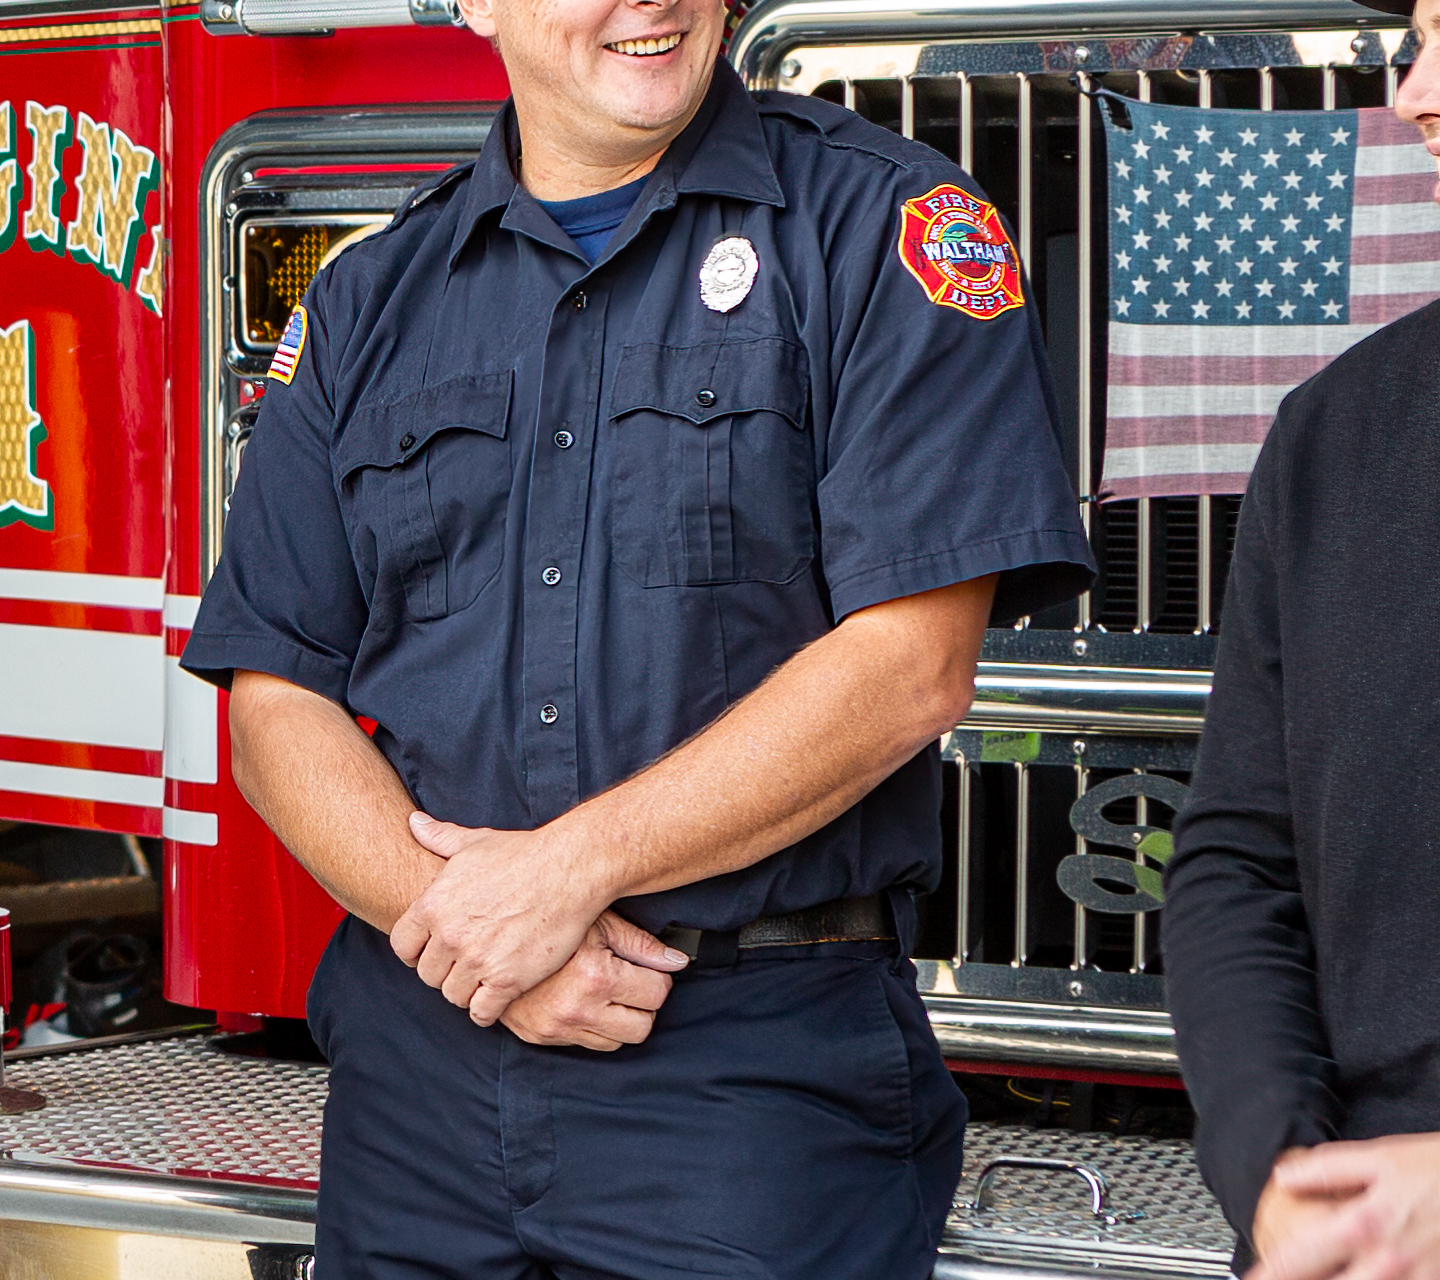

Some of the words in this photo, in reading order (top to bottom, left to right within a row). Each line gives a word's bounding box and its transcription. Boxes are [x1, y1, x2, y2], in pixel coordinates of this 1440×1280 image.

[925, 194, 981, 215] FIRE
[921, 242, 1006, 263] WALTHAM
[950, 289, 1007, 310] DEPT
